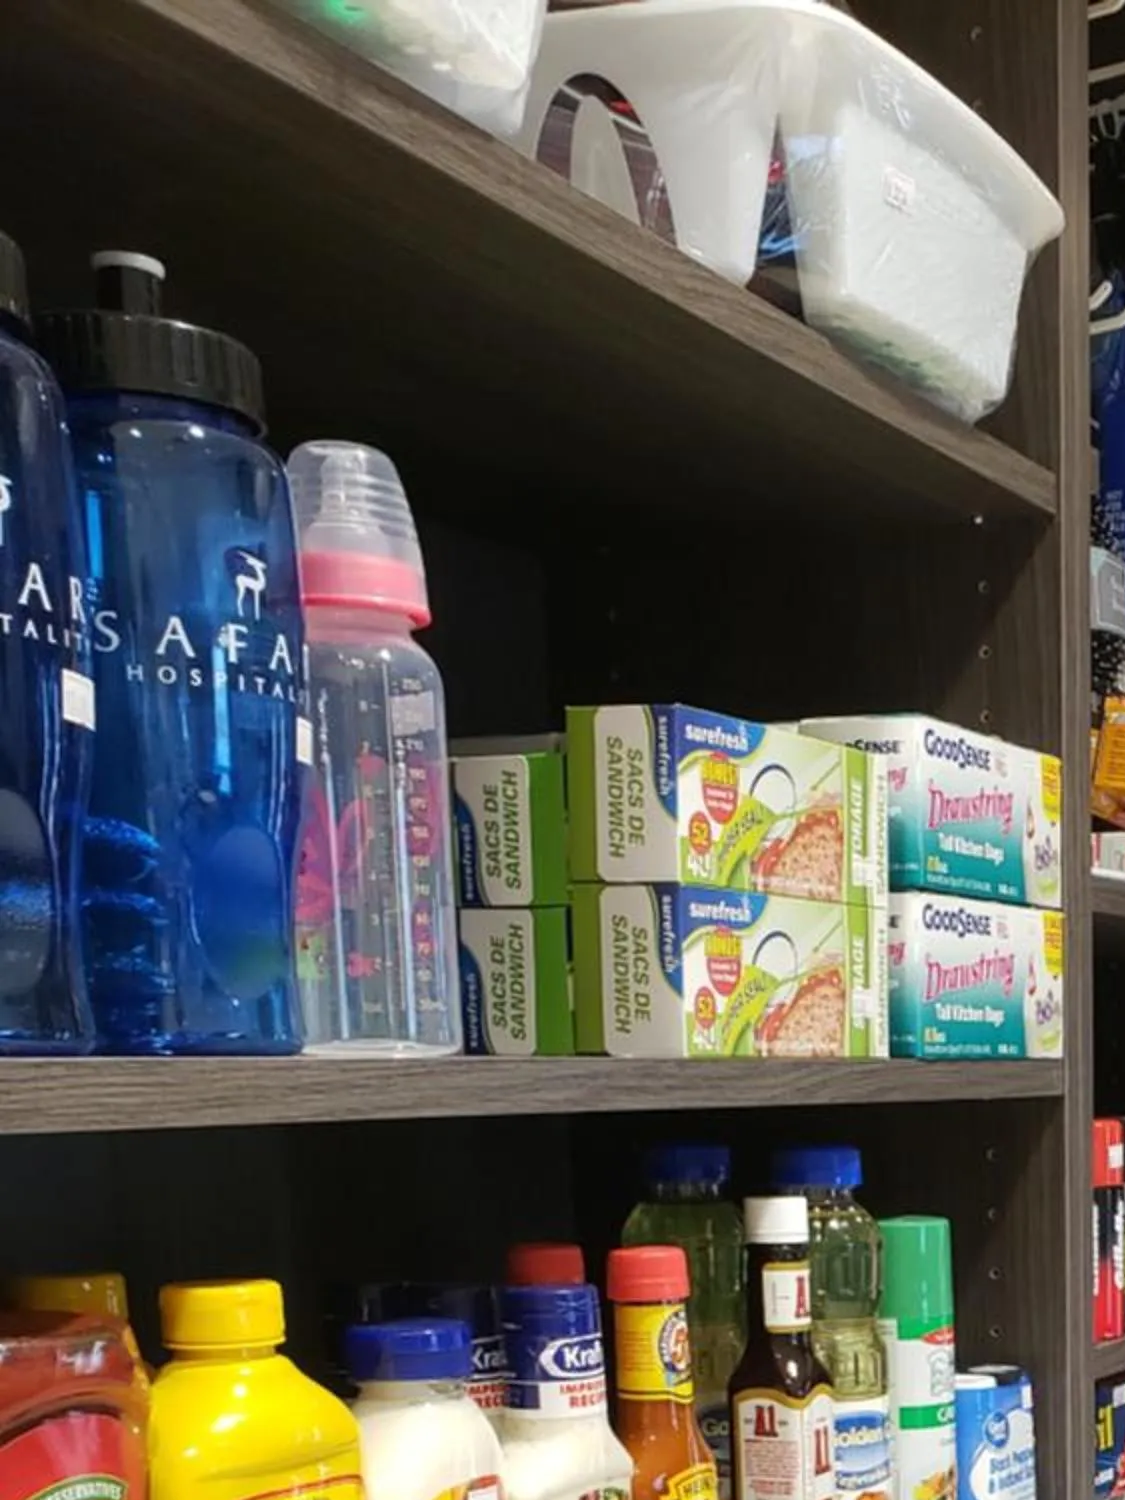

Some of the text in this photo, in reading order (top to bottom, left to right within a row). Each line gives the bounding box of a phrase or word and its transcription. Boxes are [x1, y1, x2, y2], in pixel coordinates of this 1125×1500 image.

[657, 715, 675, 797] surefresh
[684, 722, 749, 750] surefresh
[482, 784, 501, 879] SACS DE
[501, 770, 522, 890] SANDWICH
[606, 736, 625, 860] SANDWICH
[627, 747, 646, 846] SACS DE
[927, 778, 1014, 836] Drawstring
[661, 895, 680, 975] surefresh
[689, 898, 751, 924] surefresh
[489, 934, 508, 1032] SACS DE
[507, 923, 526, 1042] SANDWICH
[611, 914, 631, 1035] SANDWICH
[632, 925, 651, 1023] SACS DE
[925, 949, 1015, 1002] Drawstring
